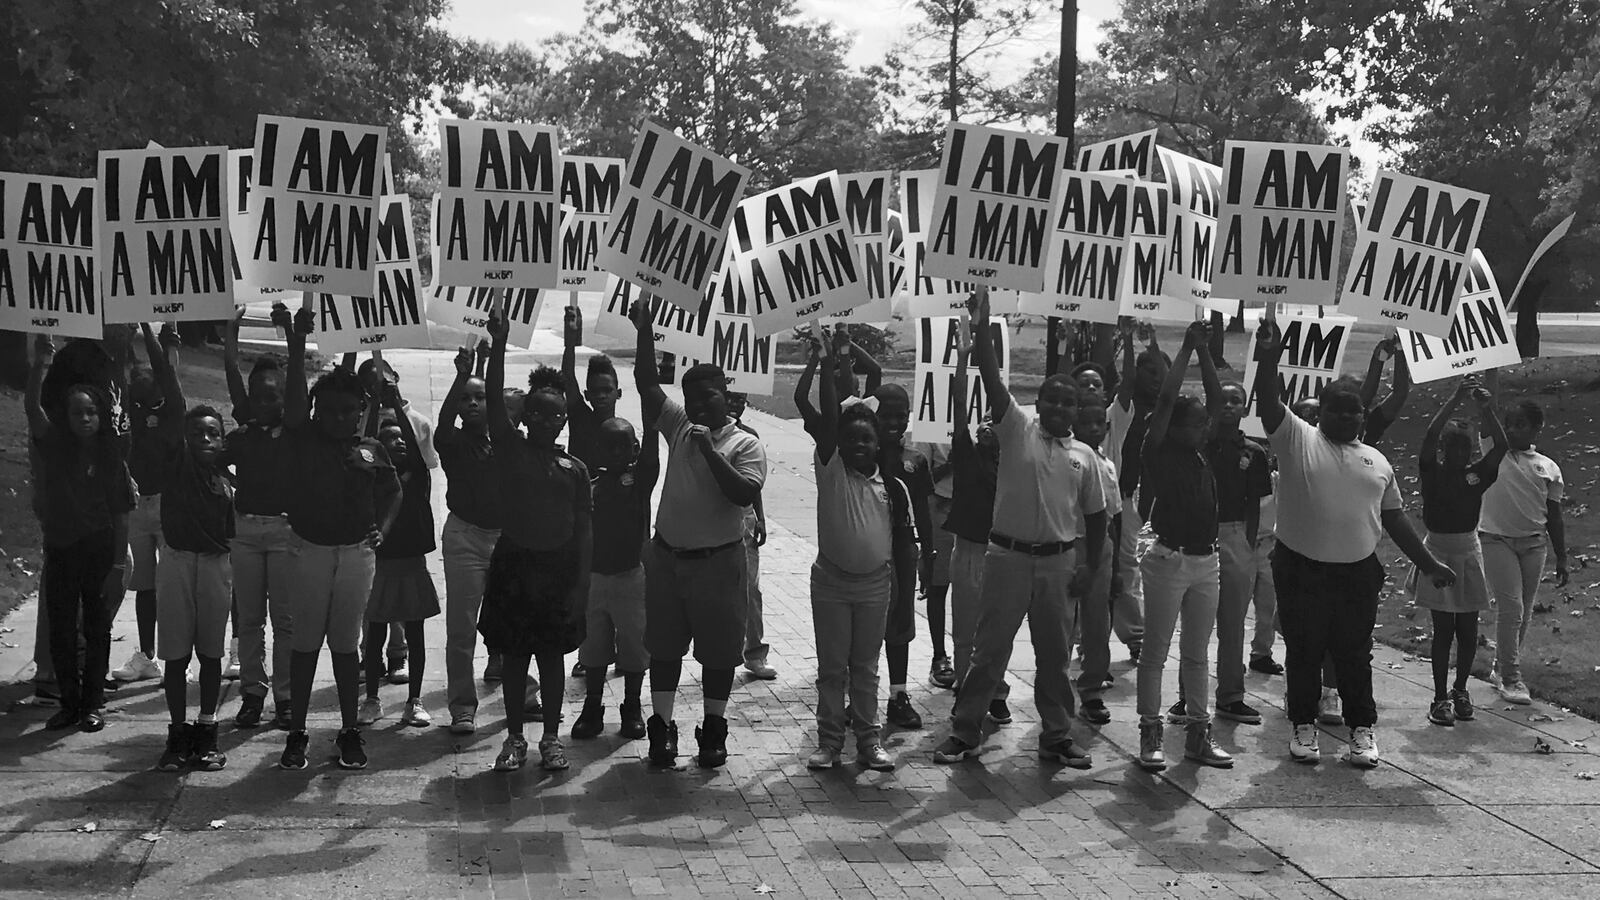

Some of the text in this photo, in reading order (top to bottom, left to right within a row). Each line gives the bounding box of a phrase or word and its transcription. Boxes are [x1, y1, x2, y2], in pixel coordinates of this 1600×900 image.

[105, 154, 221, 221] I AM
[259, 123, 279, 187] I
[287, 127, 379, 197] AM
[446, 125, 461, 188] I
[475, 128, 554, 192] AM
[560, 161, 620, 213] AM
[629, 129, 742, 230] I AM
[945, 128, 1059, 200] I AM
[1100, 135, 1152, 177] AM
[1164, 153, 1181, 206] I
[1226, 147, 1342, 211] I AM
[18, 182, 94, 247] AM
[253, 197, 277, 262] A
[293, 200, 372, 271] MAN
[447, 198, 468, 261] A
[483, 199, 554, 264] MAN
[734, 206, 752, 254] I
[766, 176, 840, 245] AM
[907, 177, 920, 234] I
[933, 195, 958, 255] A
[969, 200, 1048, 268] MAN
[1057, 177, 1128, 238] AM
[1367, 177, 1480, 254] I AM
[111, 231, 135, 296] A
[146, 228, 226, 296] MAN
[608, 196, 639, 255] A
[639, 208, 717, 291] MAN
[751, 258, 777, 315] A
[778, 228, 857, 303] MAN
[1056, 239, 1123, 301] MAN
[1169, 214, 1182, 275] A
[1220, 214, 1242, 275] A
[1257, 216, 1336, 281] MAN
[28, 251, 95, 315] MAN
[1350, 241, 1463, 316] A MAN
[712, 319, 771, 374] MAN
[921, 317, 932, 364] I
[1280, 320, 1345, 370] AM
[1442, 297, 1508, 356] MAN
[919, 371, 936, 422] A
